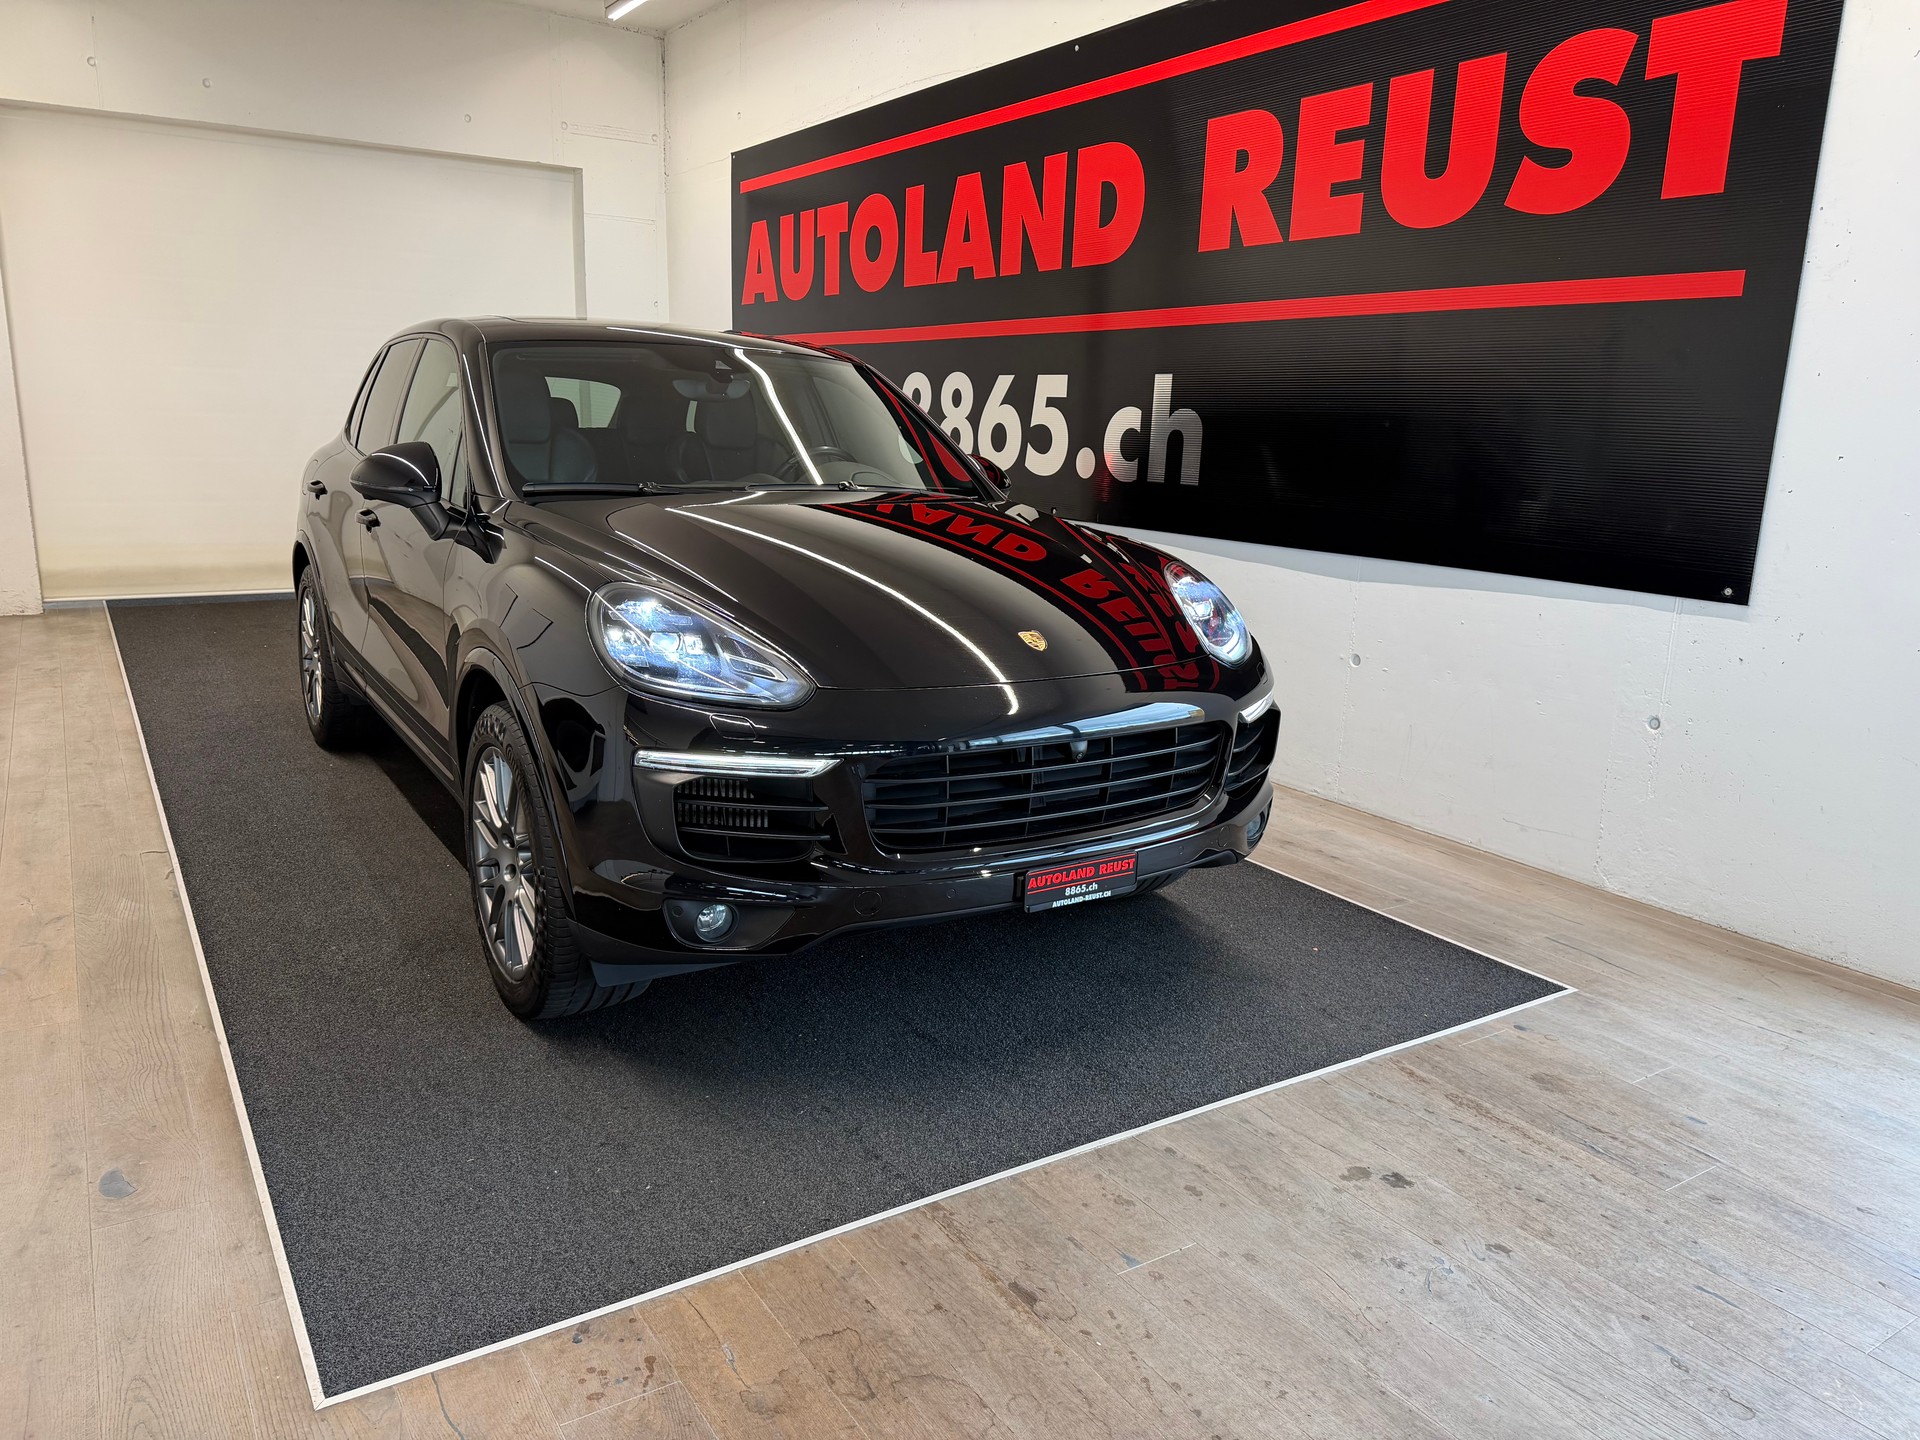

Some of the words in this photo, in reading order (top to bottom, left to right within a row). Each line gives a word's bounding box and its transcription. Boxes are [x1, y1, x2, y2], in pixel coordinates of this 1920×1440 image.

[743, 141, 1145, 305] AUTOLAND
[1199, 0, 1788, 252] REUST
[1027, 867, 1095, 889] AUTOLAND
[1099, 858, 1136, 875] REUST
[1052, 890, 1112, 908] AUTOLAND-REUST.CH
[1065, 882, 1098, 896] 8865.ch
